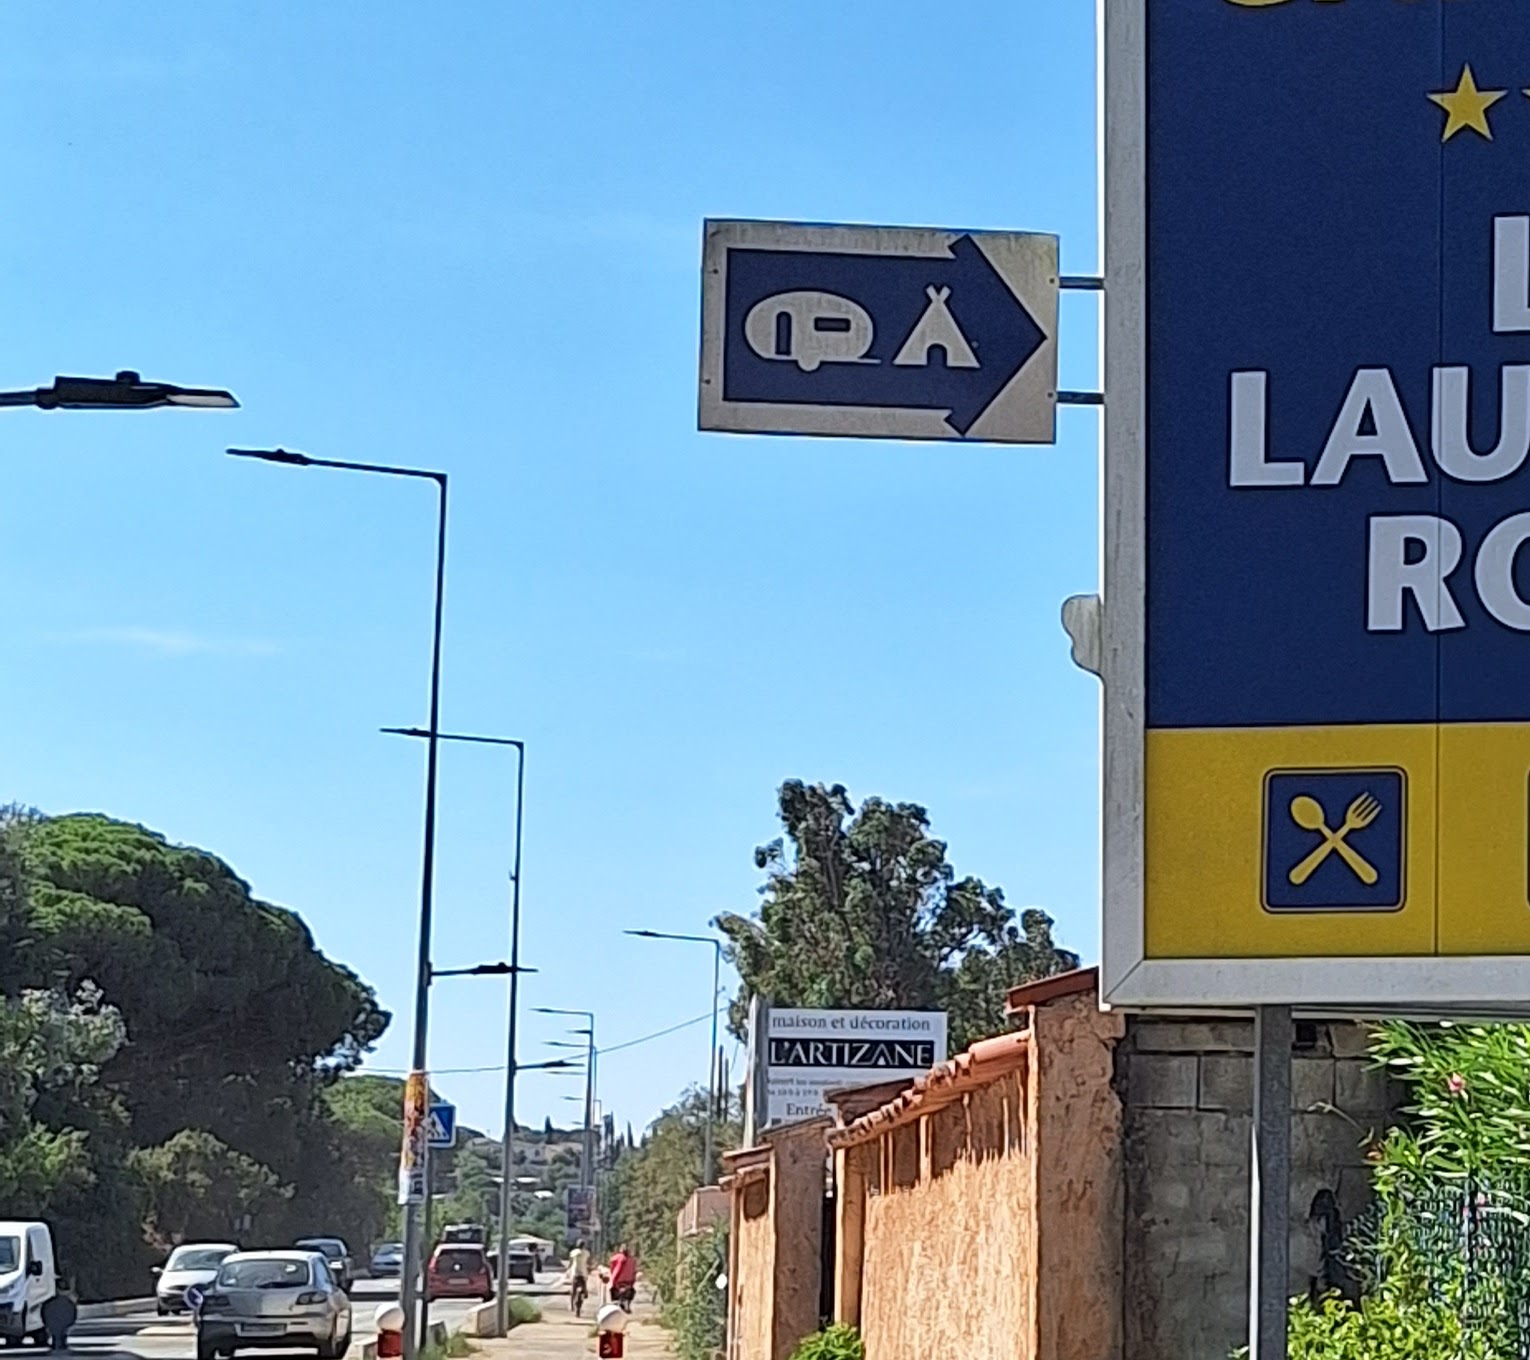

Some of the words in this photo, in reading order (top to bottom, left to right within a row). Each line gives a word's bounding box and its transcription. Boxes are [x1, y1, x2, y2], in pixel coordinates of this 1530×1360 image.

[773, 1015, 827, 1029] maison
[831, 1016, 845, 1029] et
[850, 1016, 931, 1031] décoration
[770, 1041, 932, 1066] L'ARTIZANE
